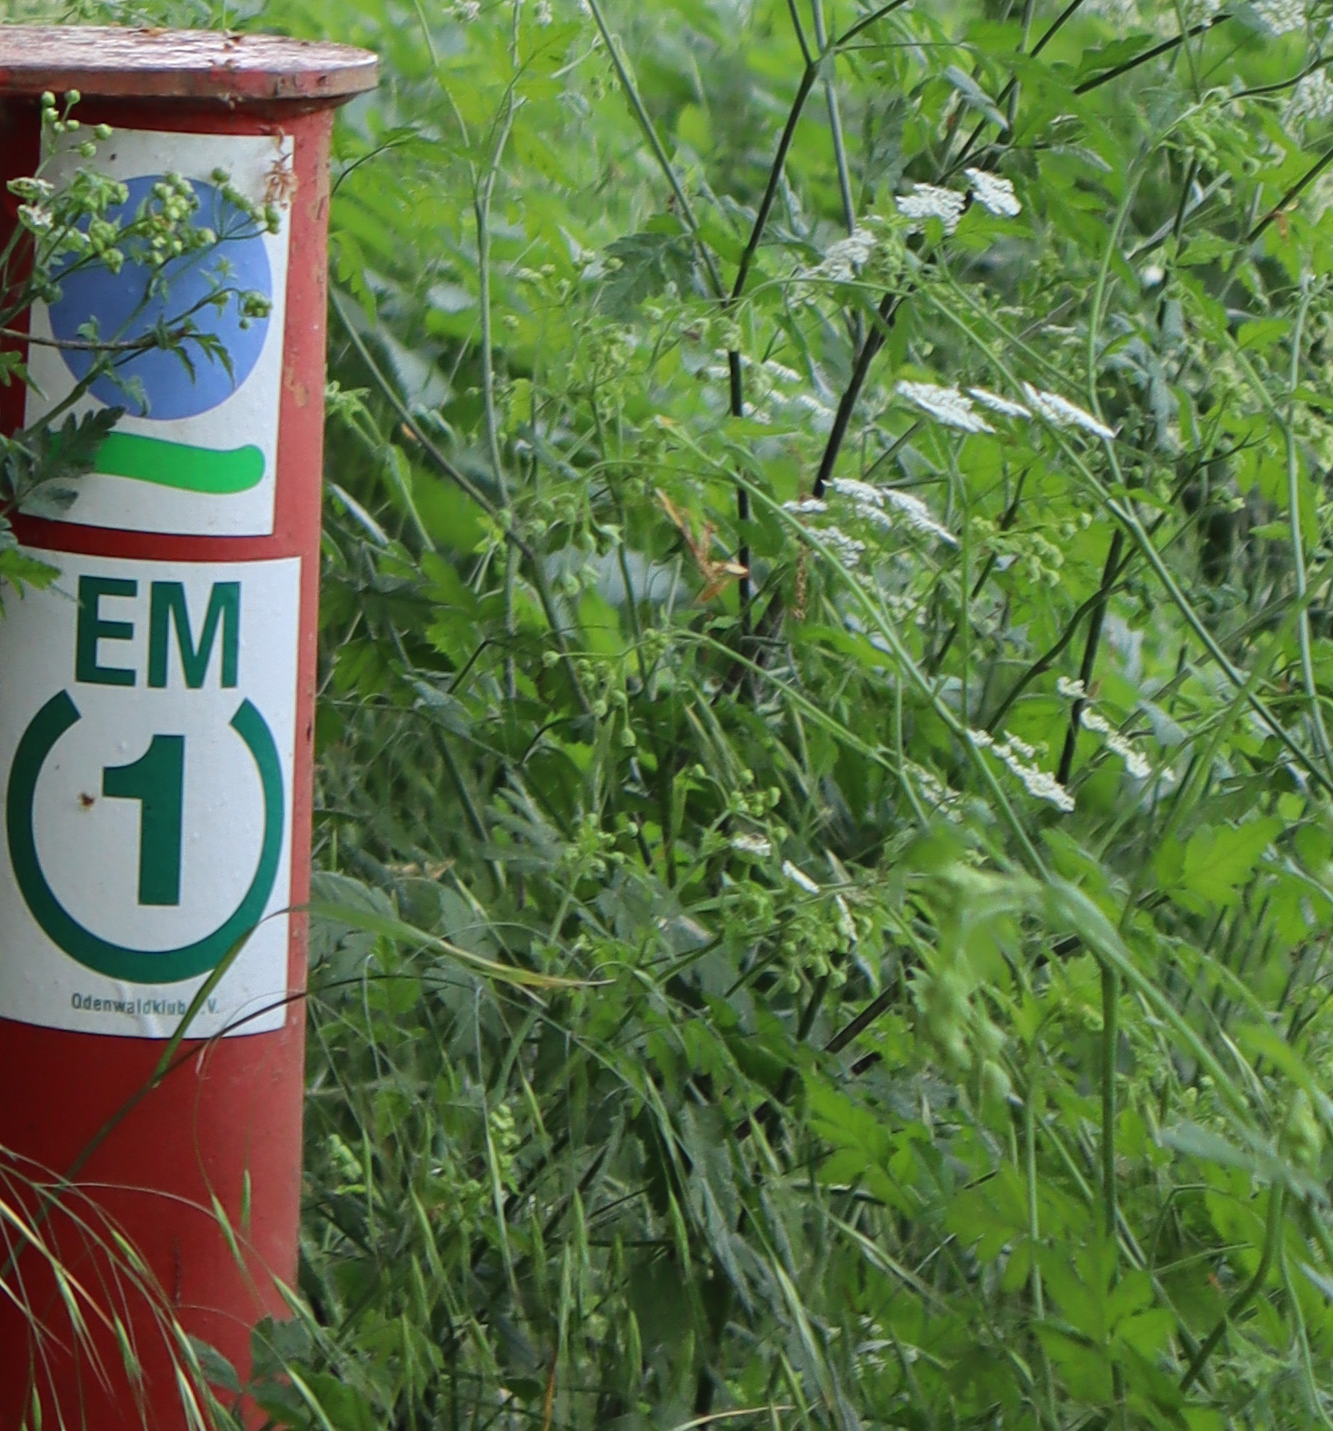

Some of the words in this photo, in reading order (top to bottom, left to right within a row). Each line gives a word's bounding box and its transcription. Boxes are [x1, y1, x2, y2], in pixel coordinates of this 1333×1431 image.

[76, 575, 241, 689] EM
[102, 734, 185, 906] 1
[71, 993, 186, 1016] Odenwaldklub
